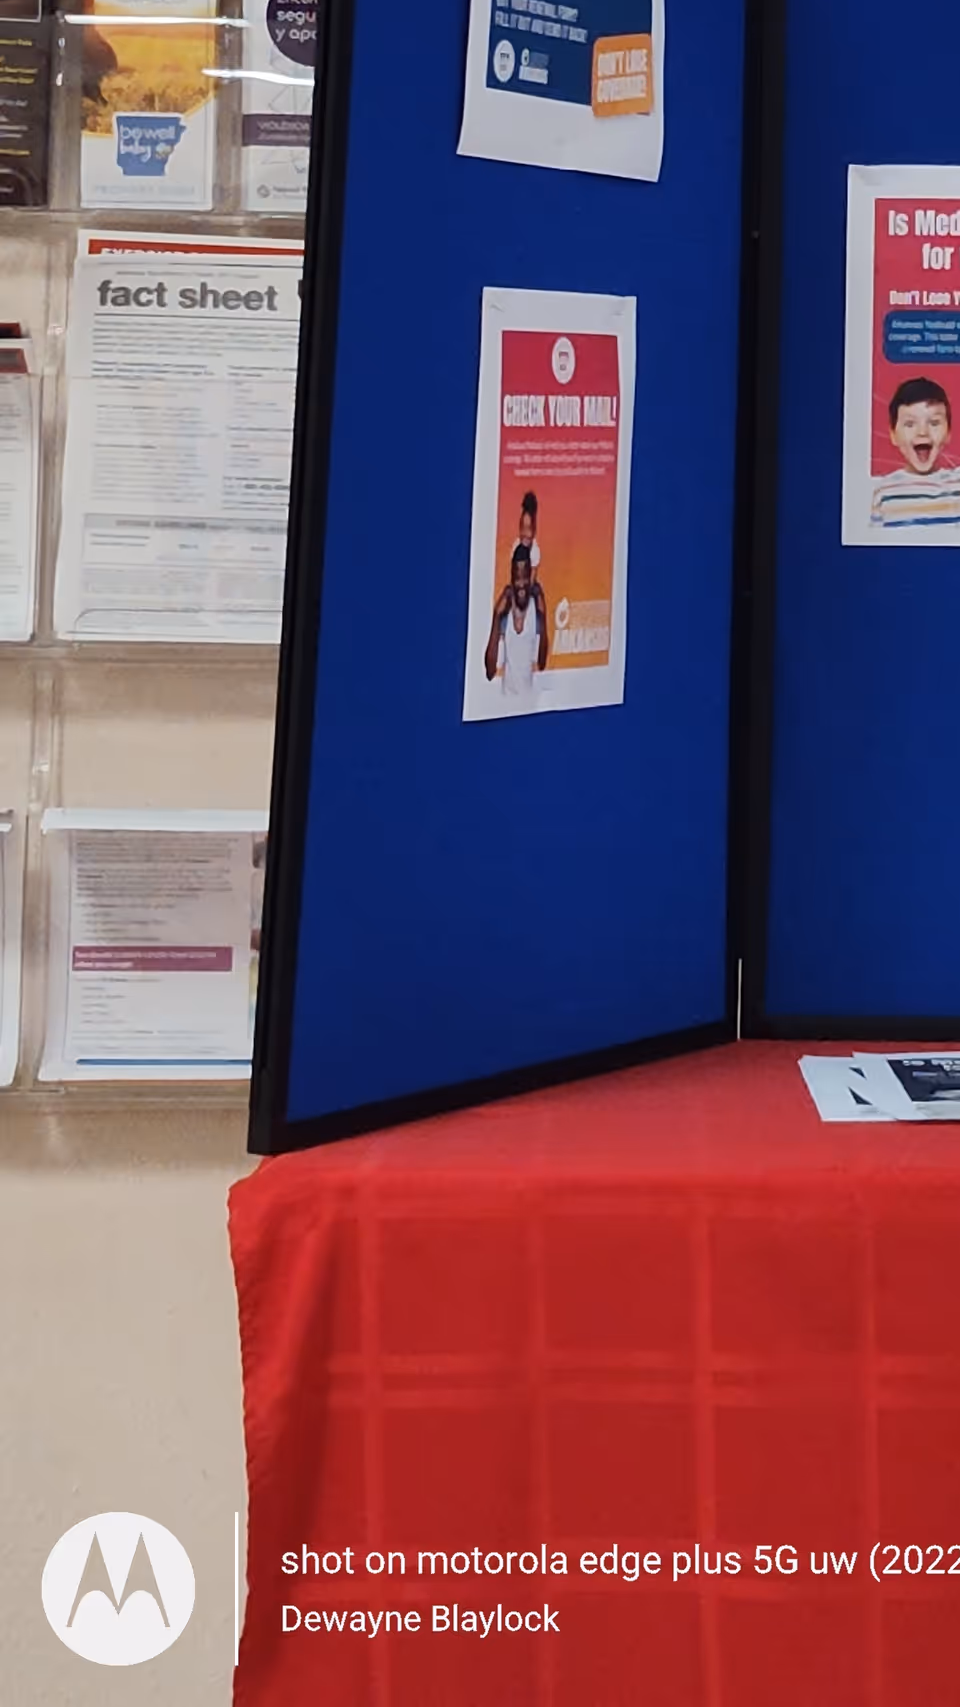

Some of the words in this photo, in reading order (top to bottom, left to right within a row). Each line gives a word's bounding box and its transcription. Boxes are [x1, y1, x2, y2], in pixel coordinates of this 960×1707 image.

[275, 29, 286, 42] y
[888, 210, 909, 236] Is
[922, 243, 954, 270] for
[98, 279, 168, 308] fact
[178, 281, 278, 312] sheet
[503, 394, 545, 427] CHECK
[548, 394, 580, 427] YOUR
[583, 396, 617, 427] MAIL!
